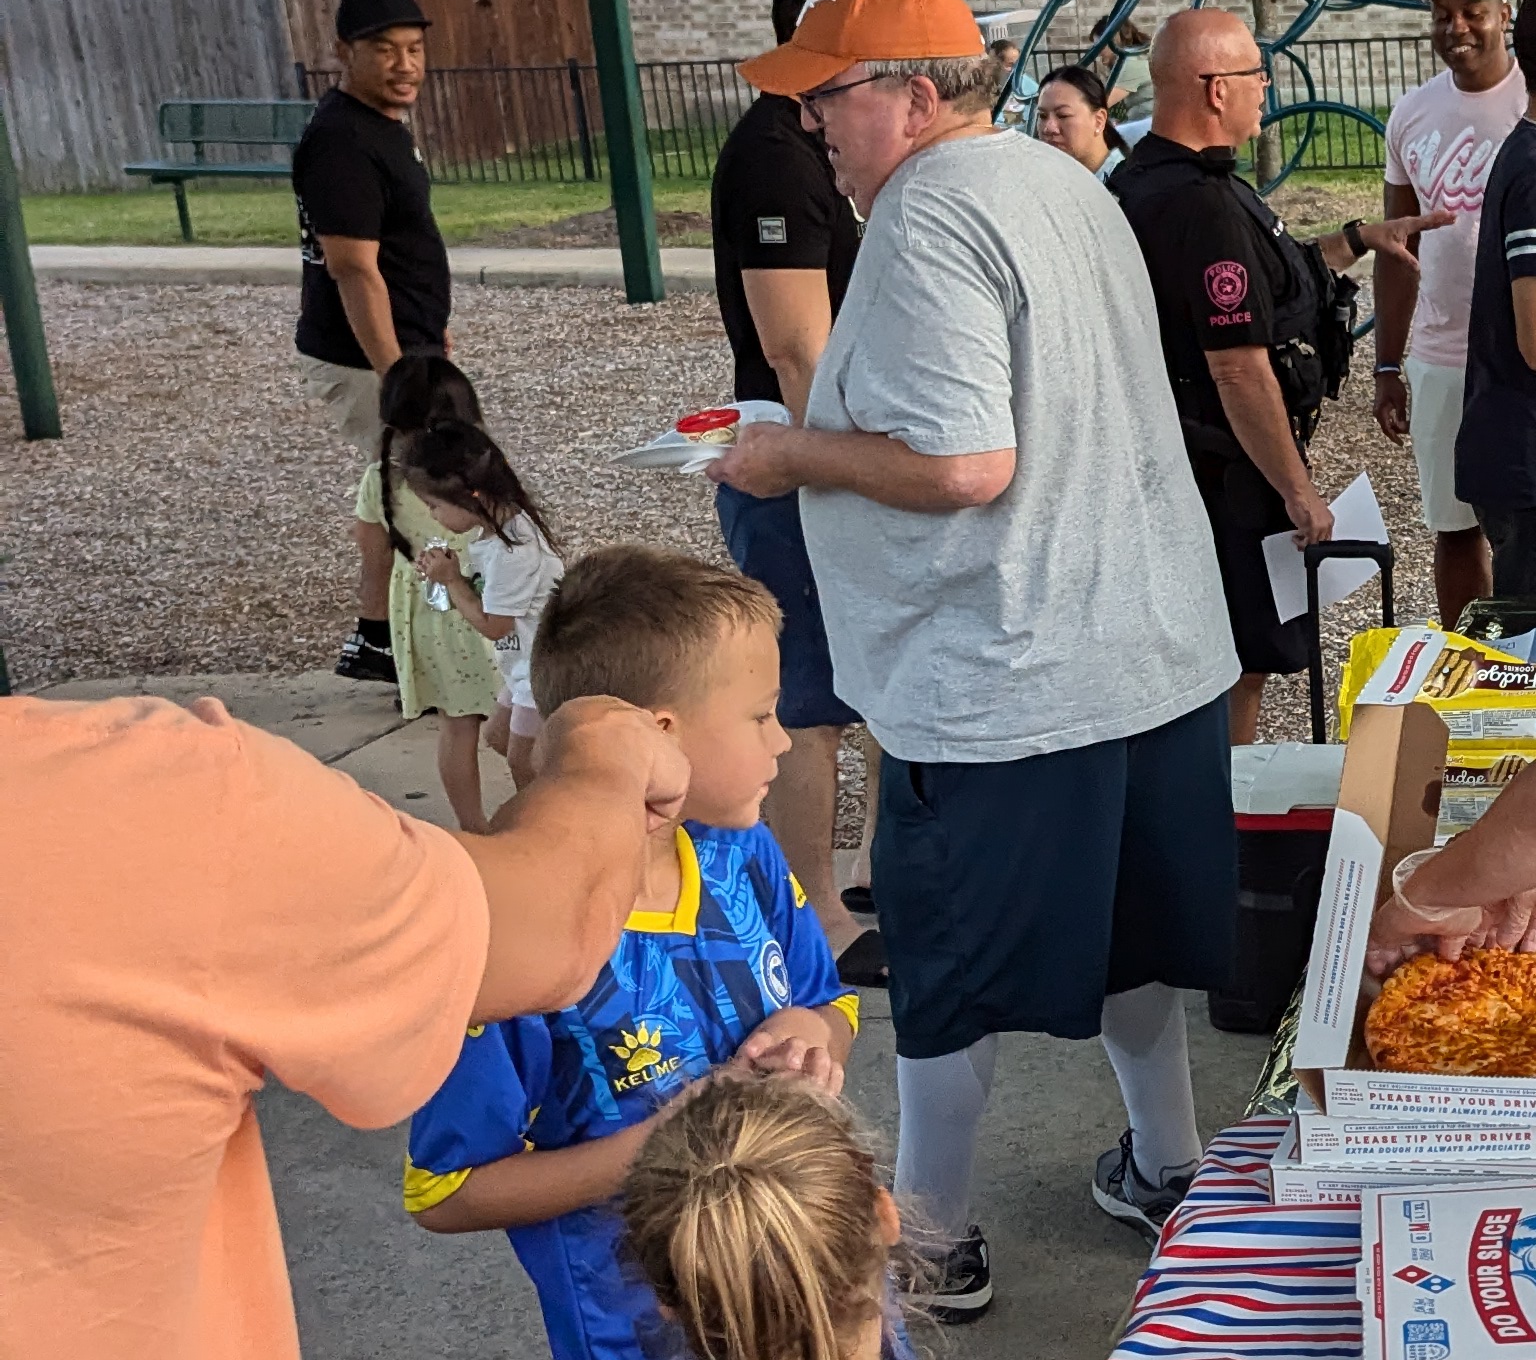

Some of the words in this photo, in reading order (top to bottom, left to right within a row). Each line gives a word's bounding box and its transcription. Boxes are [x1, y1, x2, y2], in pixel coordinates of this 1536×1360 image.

[1209, 263, 1243, 278] POLICE
[1209, 311, 1252, 327] POLICE
[1369, 1092, 1421, 1103] PLEASE
[1429, 1095, 1451, 1105] TIP
[1459, 1097, 1496, 1107] YOUR
[1402, 1105, 1435, 1113] DOUGH
[1438, 1106, 1448, 1114] IS
[1451, 1107, 1488, 1116] ALWAYS
[1345, 1135, 1398, 1145] PLEASE
[1405, 1134, 1428, 1143] TIP
[1435, 1133, 1472, 1143] YOUR
[1480, 1132, 1532, 1142] DRIVER
[1345, 1147, 1374, 1155] EXTRA
[1378, 1146, 1411, 1154] DOUGH
[1427, 1145, 1464, 1153] ALWAYS
[1467, 1143, 1531, 1152] APPRECIATED
[1318, 1192, 1362, 1202] PLEAS
[1476, 1213, 1512, 1260] SLICE
[1476, 1265, 1511, 1311] YOUR
[1489, 1314, 1528, 1338] DO
